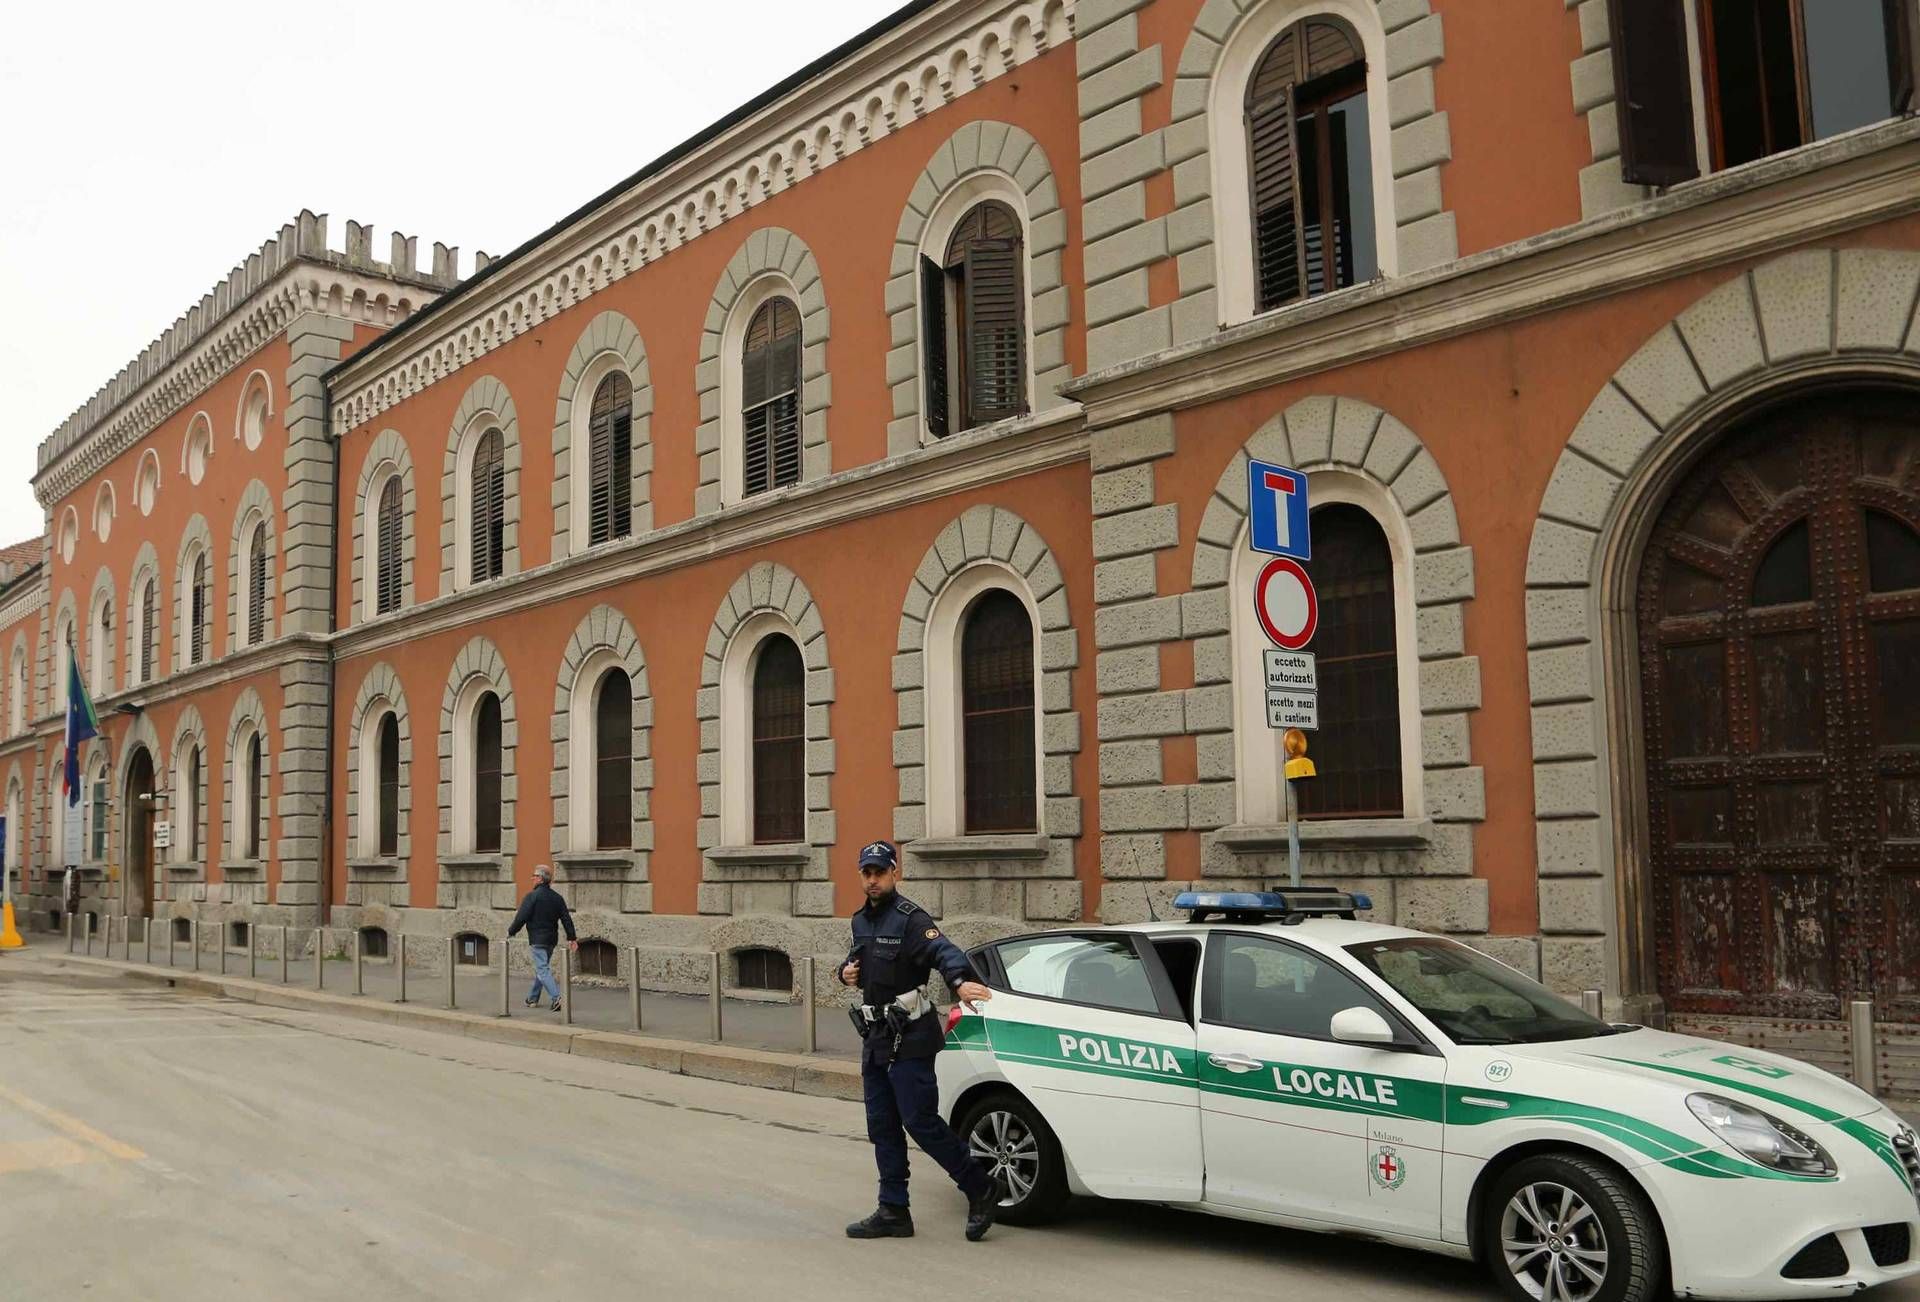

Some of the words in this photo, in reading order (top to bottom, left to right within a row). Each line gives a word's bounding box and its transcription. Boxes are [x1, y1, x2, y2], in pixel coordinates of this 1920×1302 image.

[1275, 657, 1306, 668] eccetto
[1270, 672, 1312, 684] autorizzati
[1270, 697, 1294, 708] eccetto
[1297, 698, 1314, 709] mezzi
[1275, 711, 1281, 722] di
[1285, 712, 1311, 723] cantiere
[1058, 1034, 1183, 1074] POLIZIA
[1272, 1066, 1398, 1106] LOCALE
[1488, 1064, 1508, 1078] 921
[1372, 1130, 1404, 1143] Milano
